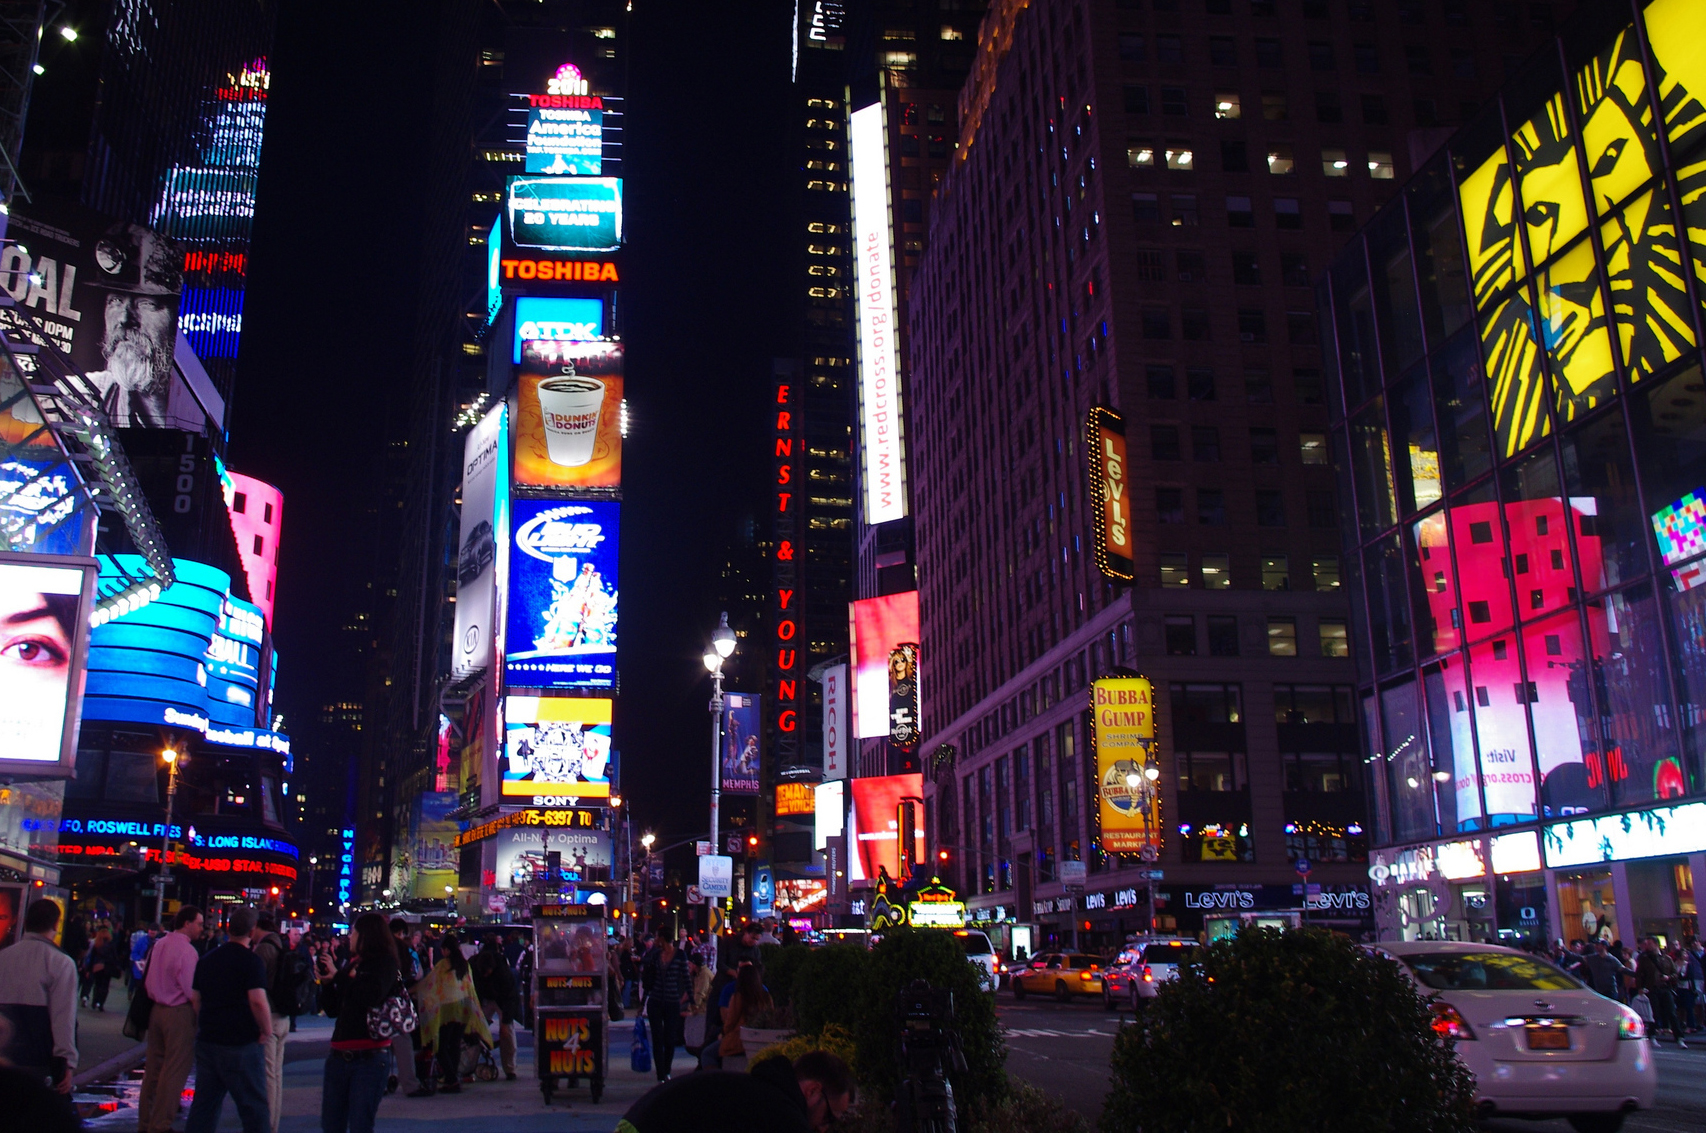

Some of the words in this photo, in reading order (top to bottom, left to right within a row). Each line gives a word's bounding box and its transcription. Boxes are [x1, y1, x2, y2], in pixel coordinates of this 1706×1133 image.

[528, 94, 603, 109] TOSHIBA
[539, 109, 592, 122] TOSHIBA
[529, 120, 602, 136] America
[527, 134, 602, 148] Foundation
[501, 260, 619, 282] TOSHIBA
[536, 321, 598, 341] TDK
[866, 232, 892, 508] www.redcross.org/donate
[556, 418, 596, 430] DONUTS
[776, 385, 792, 512] ERNST
[467, 440, 498, 476] OPTIMA
[777, 541, 794, 561] &
[778, 590, 796, 732] YOUNG
[1096, 687, 1148, 706] BUBBA
[828, 676, 836, 770] RICOH
[1101, 709, 1146, 728] GUMP
[722, 778, 760, 790] MEMPHIS
[1102, 786, 1129, 796] BUBBA
[532, 796, 580, 806] SONY
[87, 820, 151, 835] ROSWELL
[154, 824, 182, 838] FIES
[208, 836, 239, 848] LONG
[558, 834, 598, 845] Optima
[702, 882, 728, 891] CAMERA
[542, 905, 561, 916] NUTS
[567, 905, 588, 915] NUTS
[546, 977, 567, 988] NUTS
[573, 977, 593, 987] NUTS
[545, 1018, 589, 1042] NUTS
[563, 1032, 581, 1055] 4
[550, 1050, 595, 1074] NUTS
